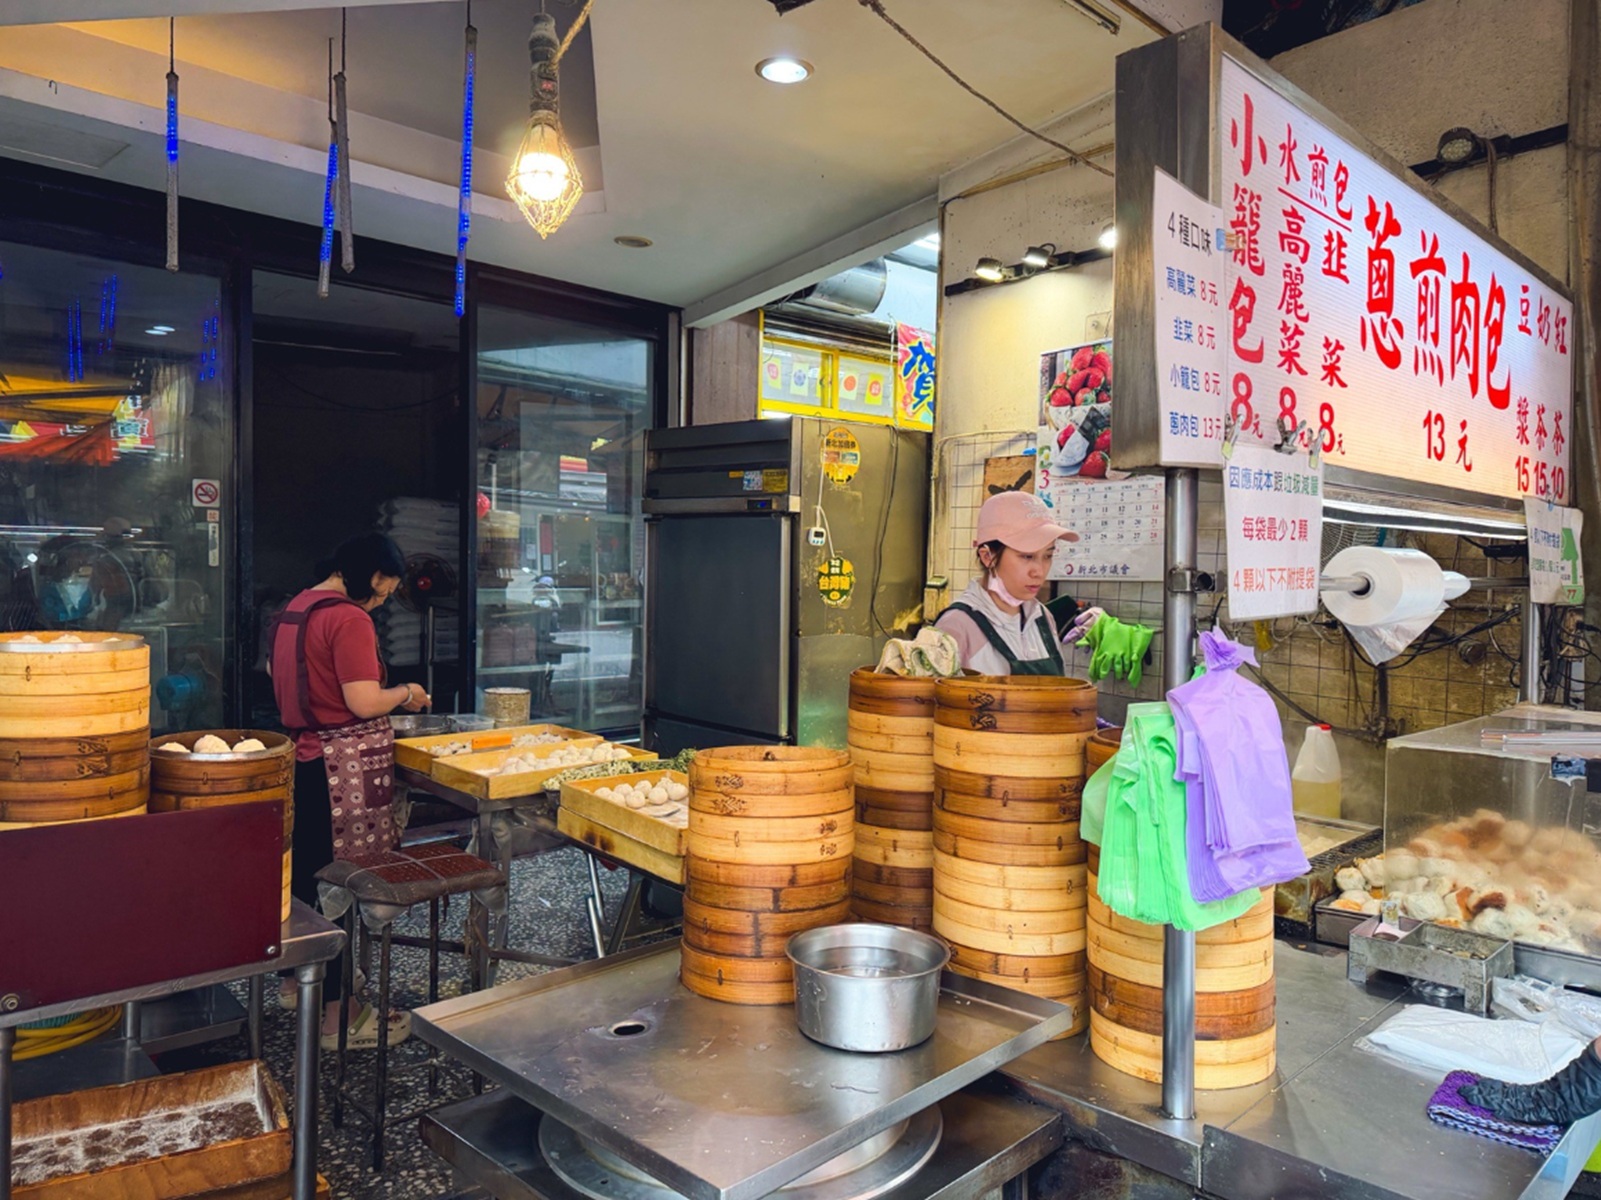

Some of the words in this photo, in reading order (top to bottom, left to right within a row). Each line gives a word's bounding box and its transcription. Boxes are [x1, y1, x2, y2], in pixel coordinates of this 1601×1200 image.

[1278, 123, 1353, 222] 水煎包
[1167, 211, 1213, 256] 4種口味
[1229, 93, 1267, 363] 小籠包
[1166, 266, 1197, 298] 高麗菜
[1200, 280, 1219, 307] 8元
[1277, 205, 1310, 376] 高麗菜
[1321, 229, 1350, 388] 韭菜
[1173, 316, 1194, 344] 韭菜
[1198, 324, 1216, 351] 8元
[1170, 364, 1200, 392] 小籠包
[1204, 372, 1222, 396] 8元
[1203, 417, 1222, 442] 13元
[1038, 470, 1050, 489] 3
[1515, 456, 1530, 492] 15
[1533, 463, 1548, 496] 15
[1550, 466, 1565, 500] 10
[1242, 516, 1309, 542] 每袋最少2顆
[1078, 563, 1130, 575] 新北市議會
